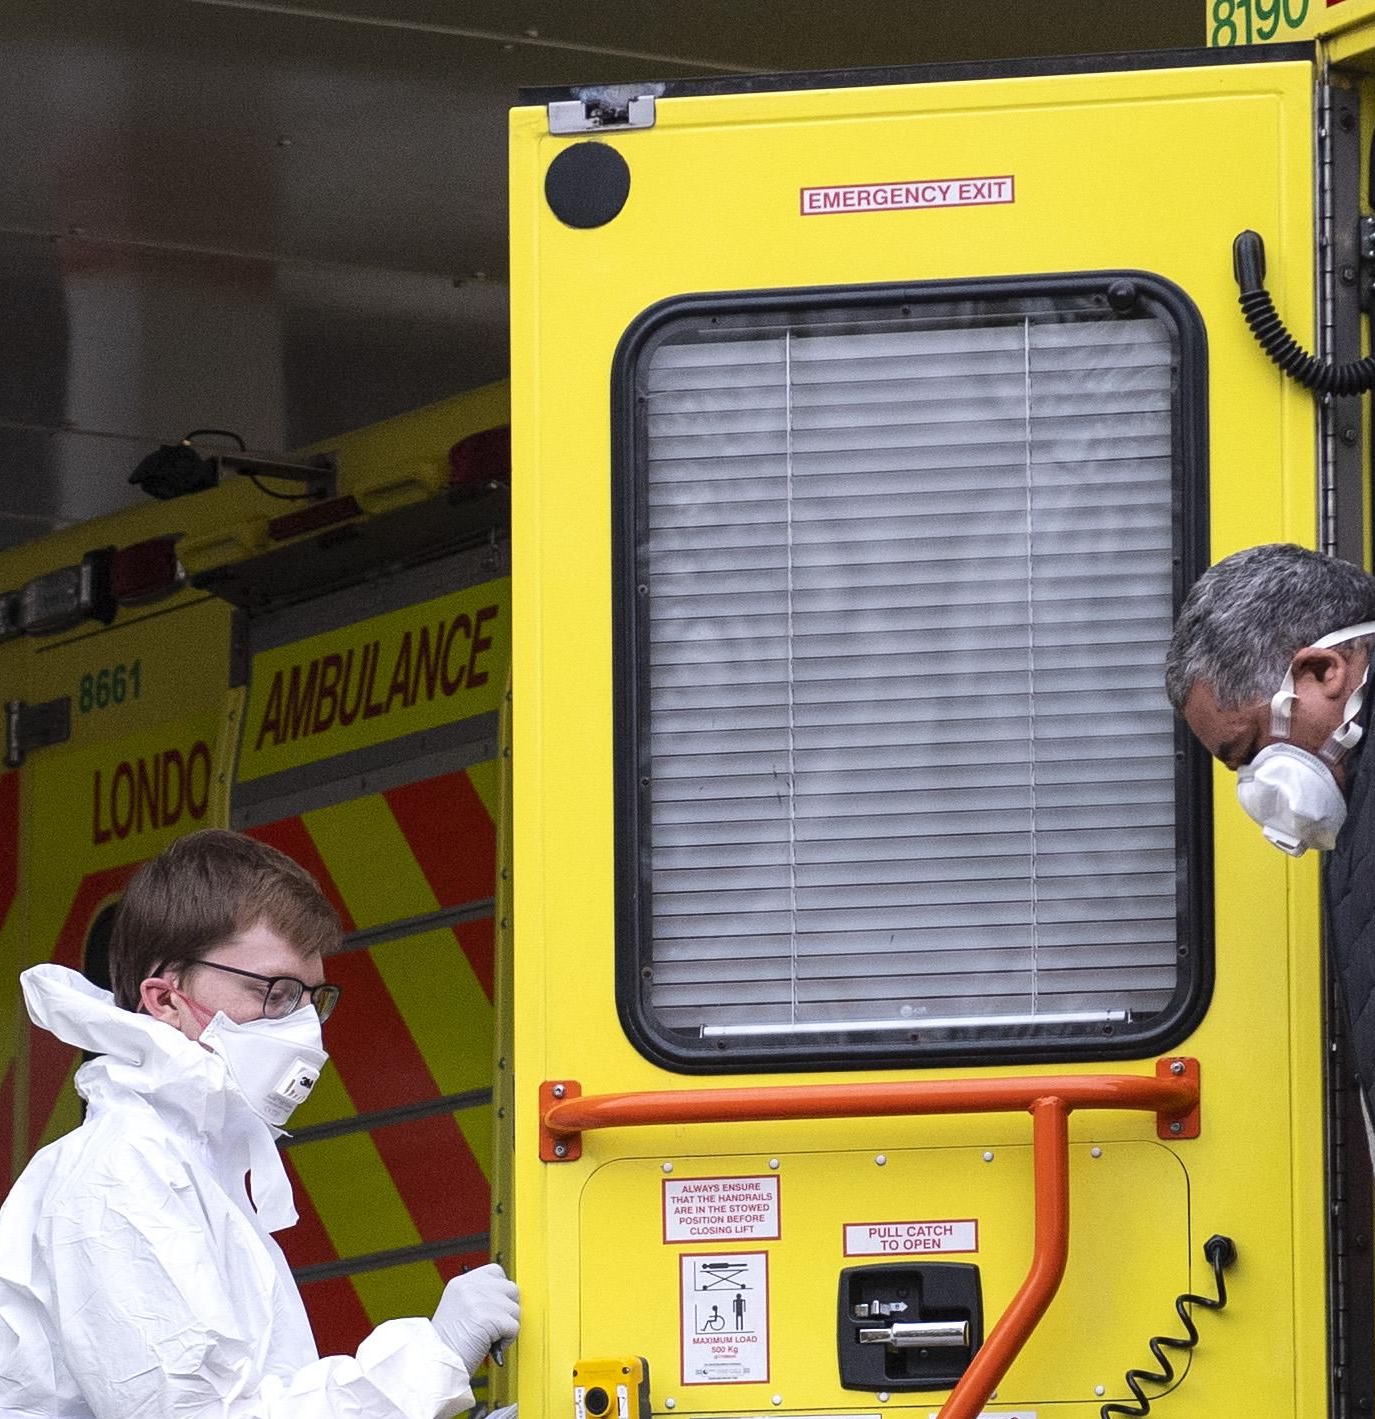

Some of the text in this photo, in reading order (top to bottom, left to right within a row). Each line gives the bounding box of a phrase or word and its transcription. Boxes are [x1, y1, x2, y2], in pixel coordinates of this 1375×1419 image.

[1212, 0, 1309, 47] 8190
[808, 181, 1006, 210] EMERGENCY EXIT
[256, 604, 499, 750] AMBULANCE
[79, 657, 141, 714] 8661
[93, 740, 212, 845] LONDO
[682, 1182, 760, 1193] ALWAYS ENSURE
[671, 1192, 772, 1204] THAT THE HANDRAILS
[674, 1206, 692, 1214] ARE
[708, 1205, 726, 1213] THE
[729, 1204, 770, 1212] STOWED
[679, 1214, 765, 1224] POSITION BEFORE
[690, 1226, 732, 1235] CLOSING
[869, 1225, 952, 1238] PULL CATCH
[881, 1238, 941, 1250] TO OPEN
